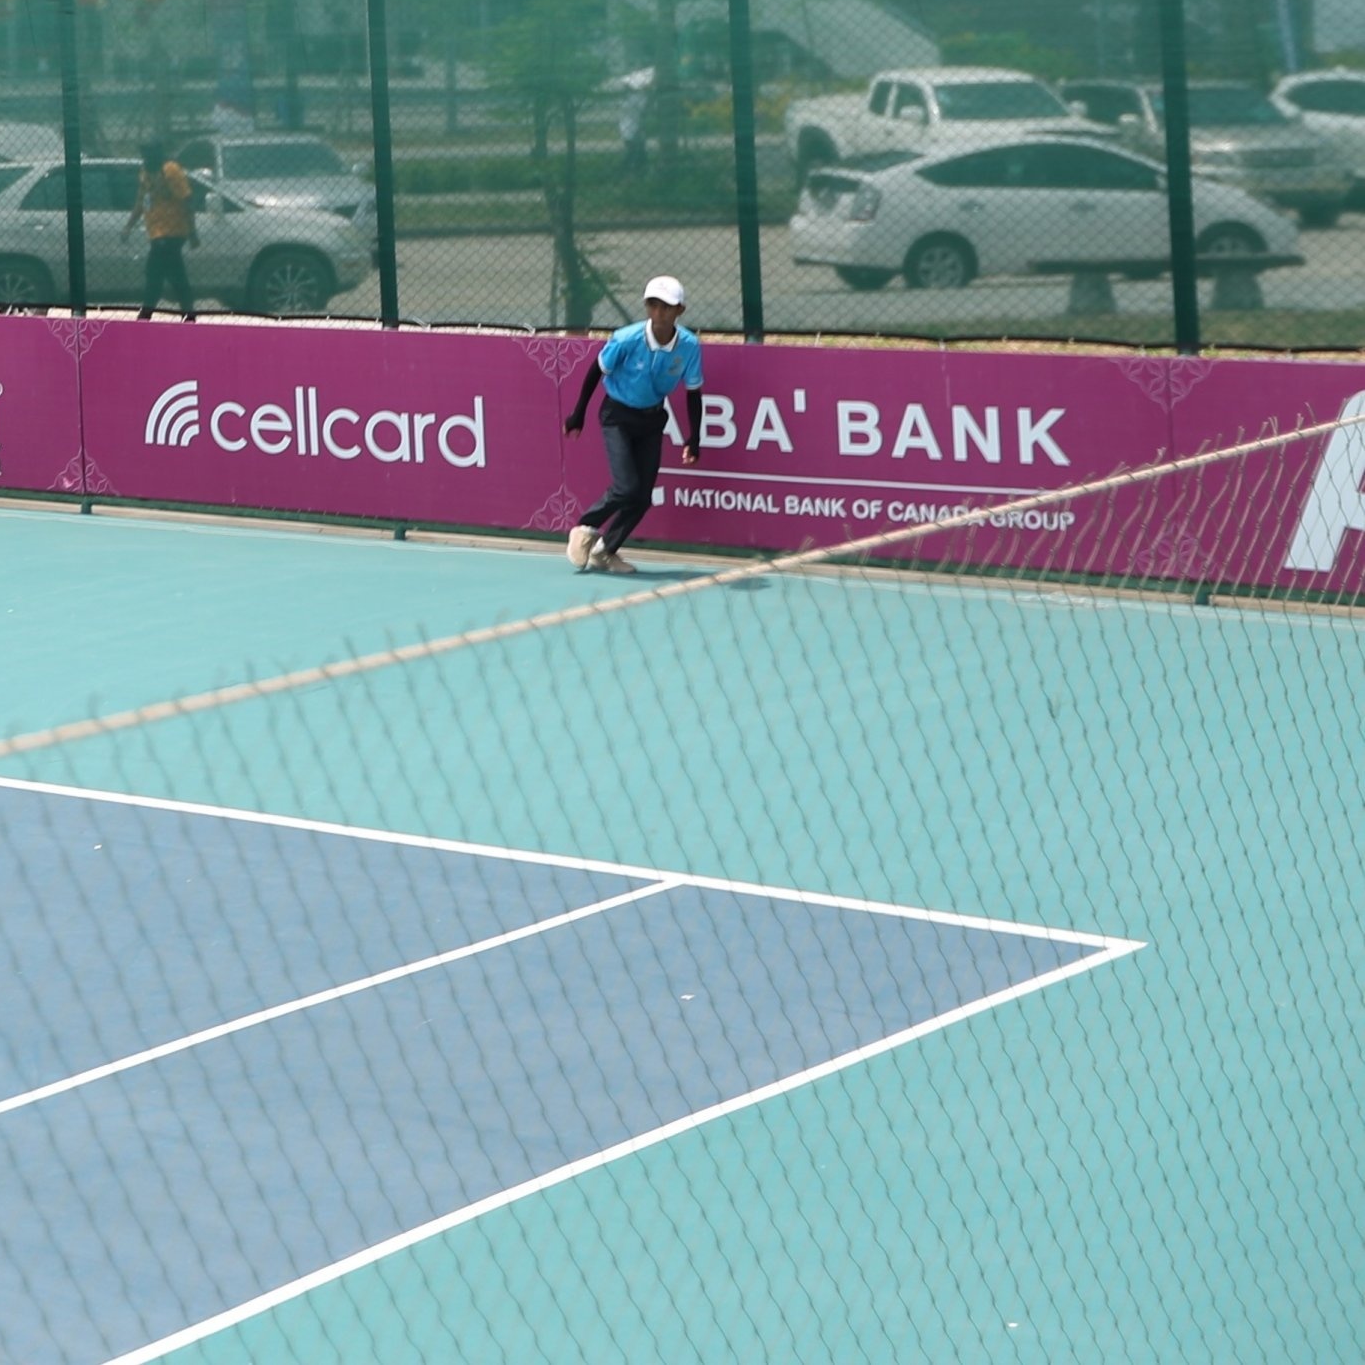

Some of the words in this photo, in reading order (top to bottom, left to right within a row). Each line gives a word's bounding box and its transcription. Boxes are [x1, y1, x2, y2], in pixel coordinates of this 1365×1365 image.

[209, 385, 486, 469] cellcard
[836, 400, 1071, 466] BANK
[674, 487, 780, 514] NATIONAL
[784, 495, 847, 518] BANK
[852, 498, 883, 520] OF
[989, 510, 1075, 532] GROUP
